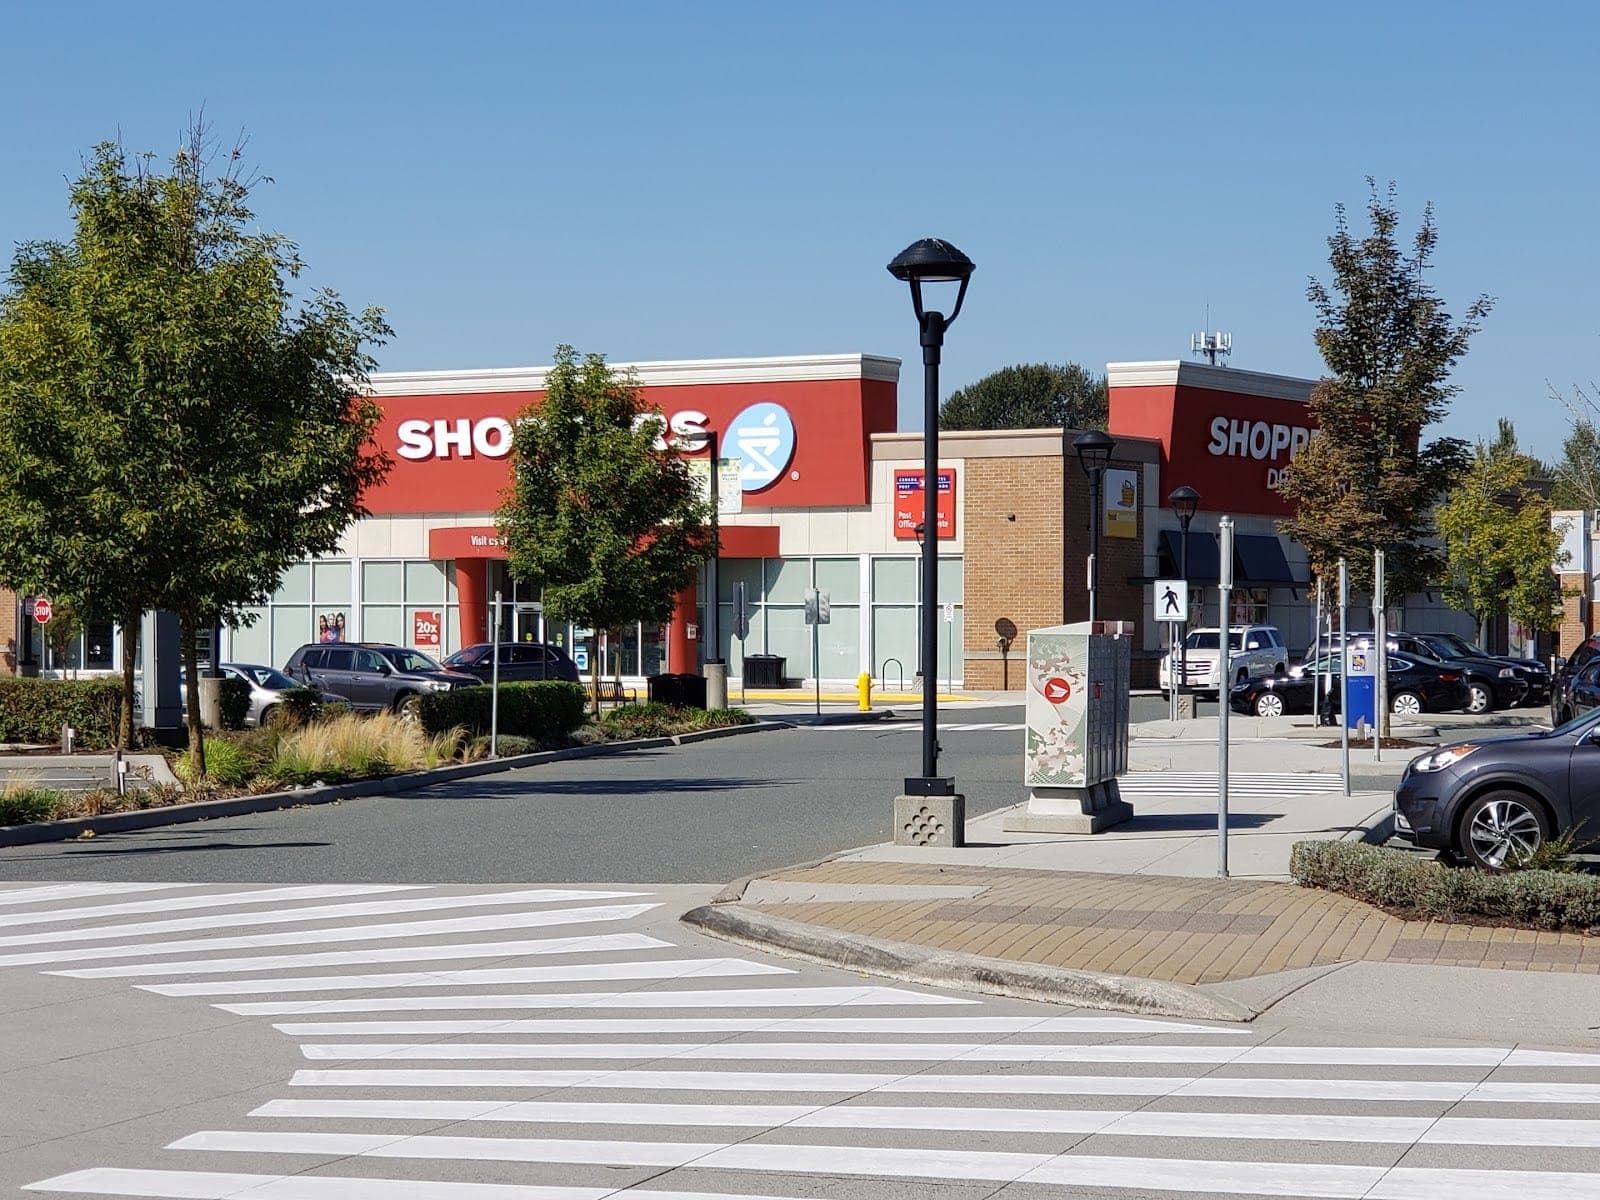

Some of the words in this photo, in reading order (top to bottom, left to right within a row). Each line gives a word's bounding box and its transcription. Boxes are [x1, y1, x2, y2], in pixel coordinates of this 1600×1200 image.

[396, 410, 709, 459] SHORS
[1208, 416, 1320, 462] SHOPP
[898, 511, 912, 519] Post
[898, 519, 917, 528] Office
[471, 536, 488, 546] Visit
[35, 607, 50, 616] STOP
[416, 622, 438, 634] 20x
